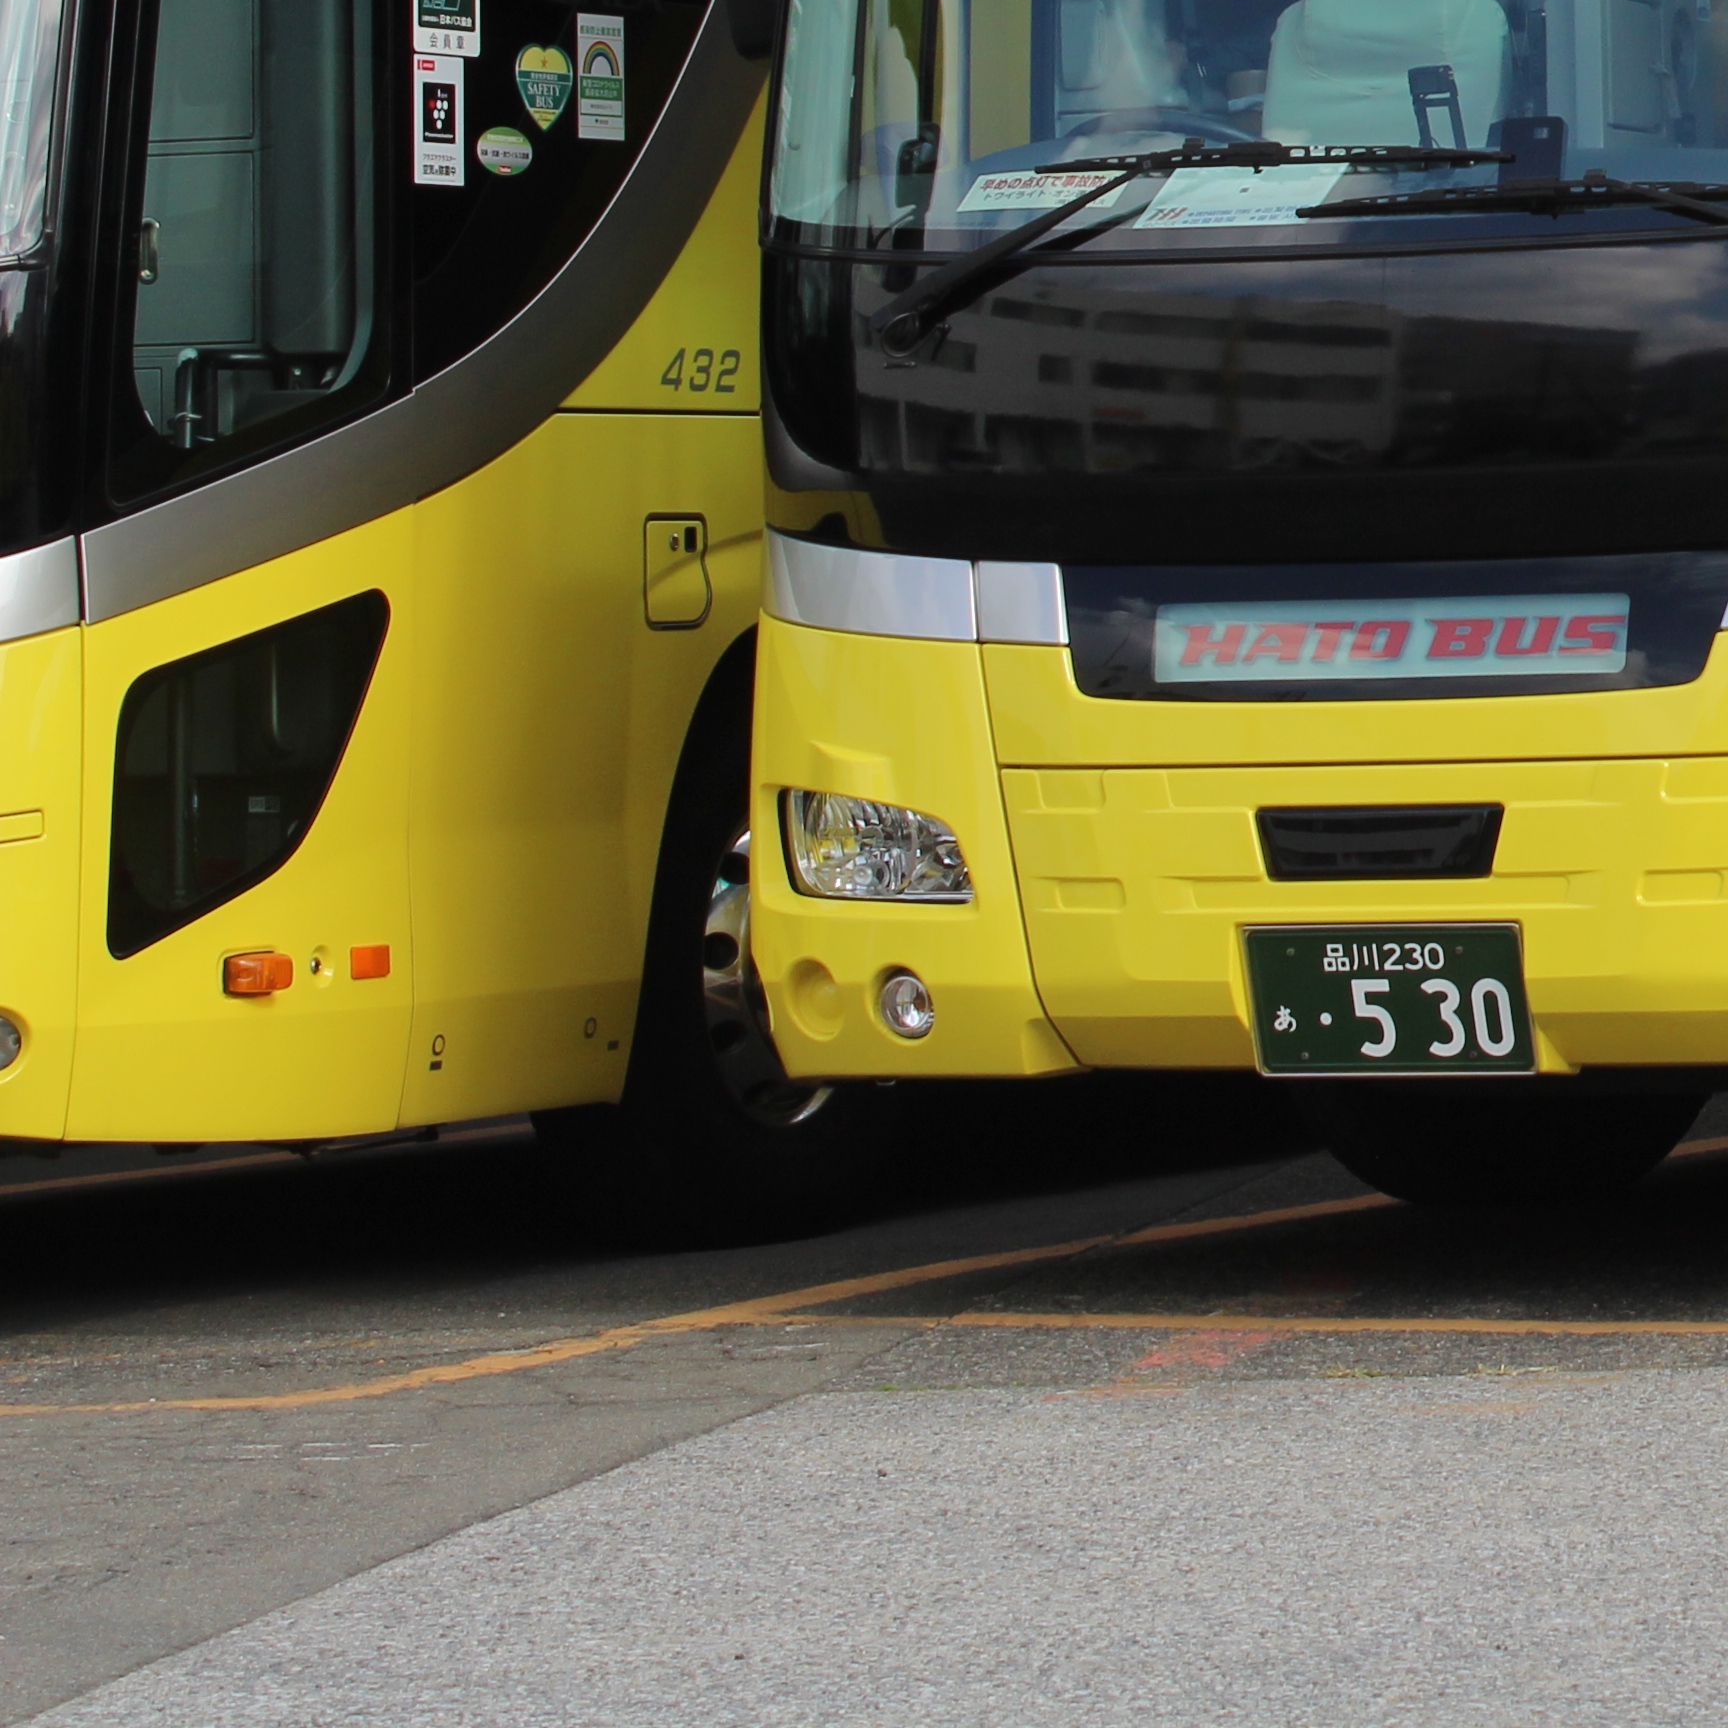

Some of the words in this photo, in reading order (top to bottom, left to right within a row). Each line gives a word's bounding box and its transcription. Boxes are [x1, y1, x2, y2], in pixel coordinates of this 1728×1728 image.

[527, 83, 561, 96] SAFETY
[535, 96, 554, 109] BUS
[661, 347, 741, 393] 432
[1178, 617, 1410, 666] HATO
[1425, 614, 1627, 659] BUS
[1274, 1005, 1297, 1033] あ
